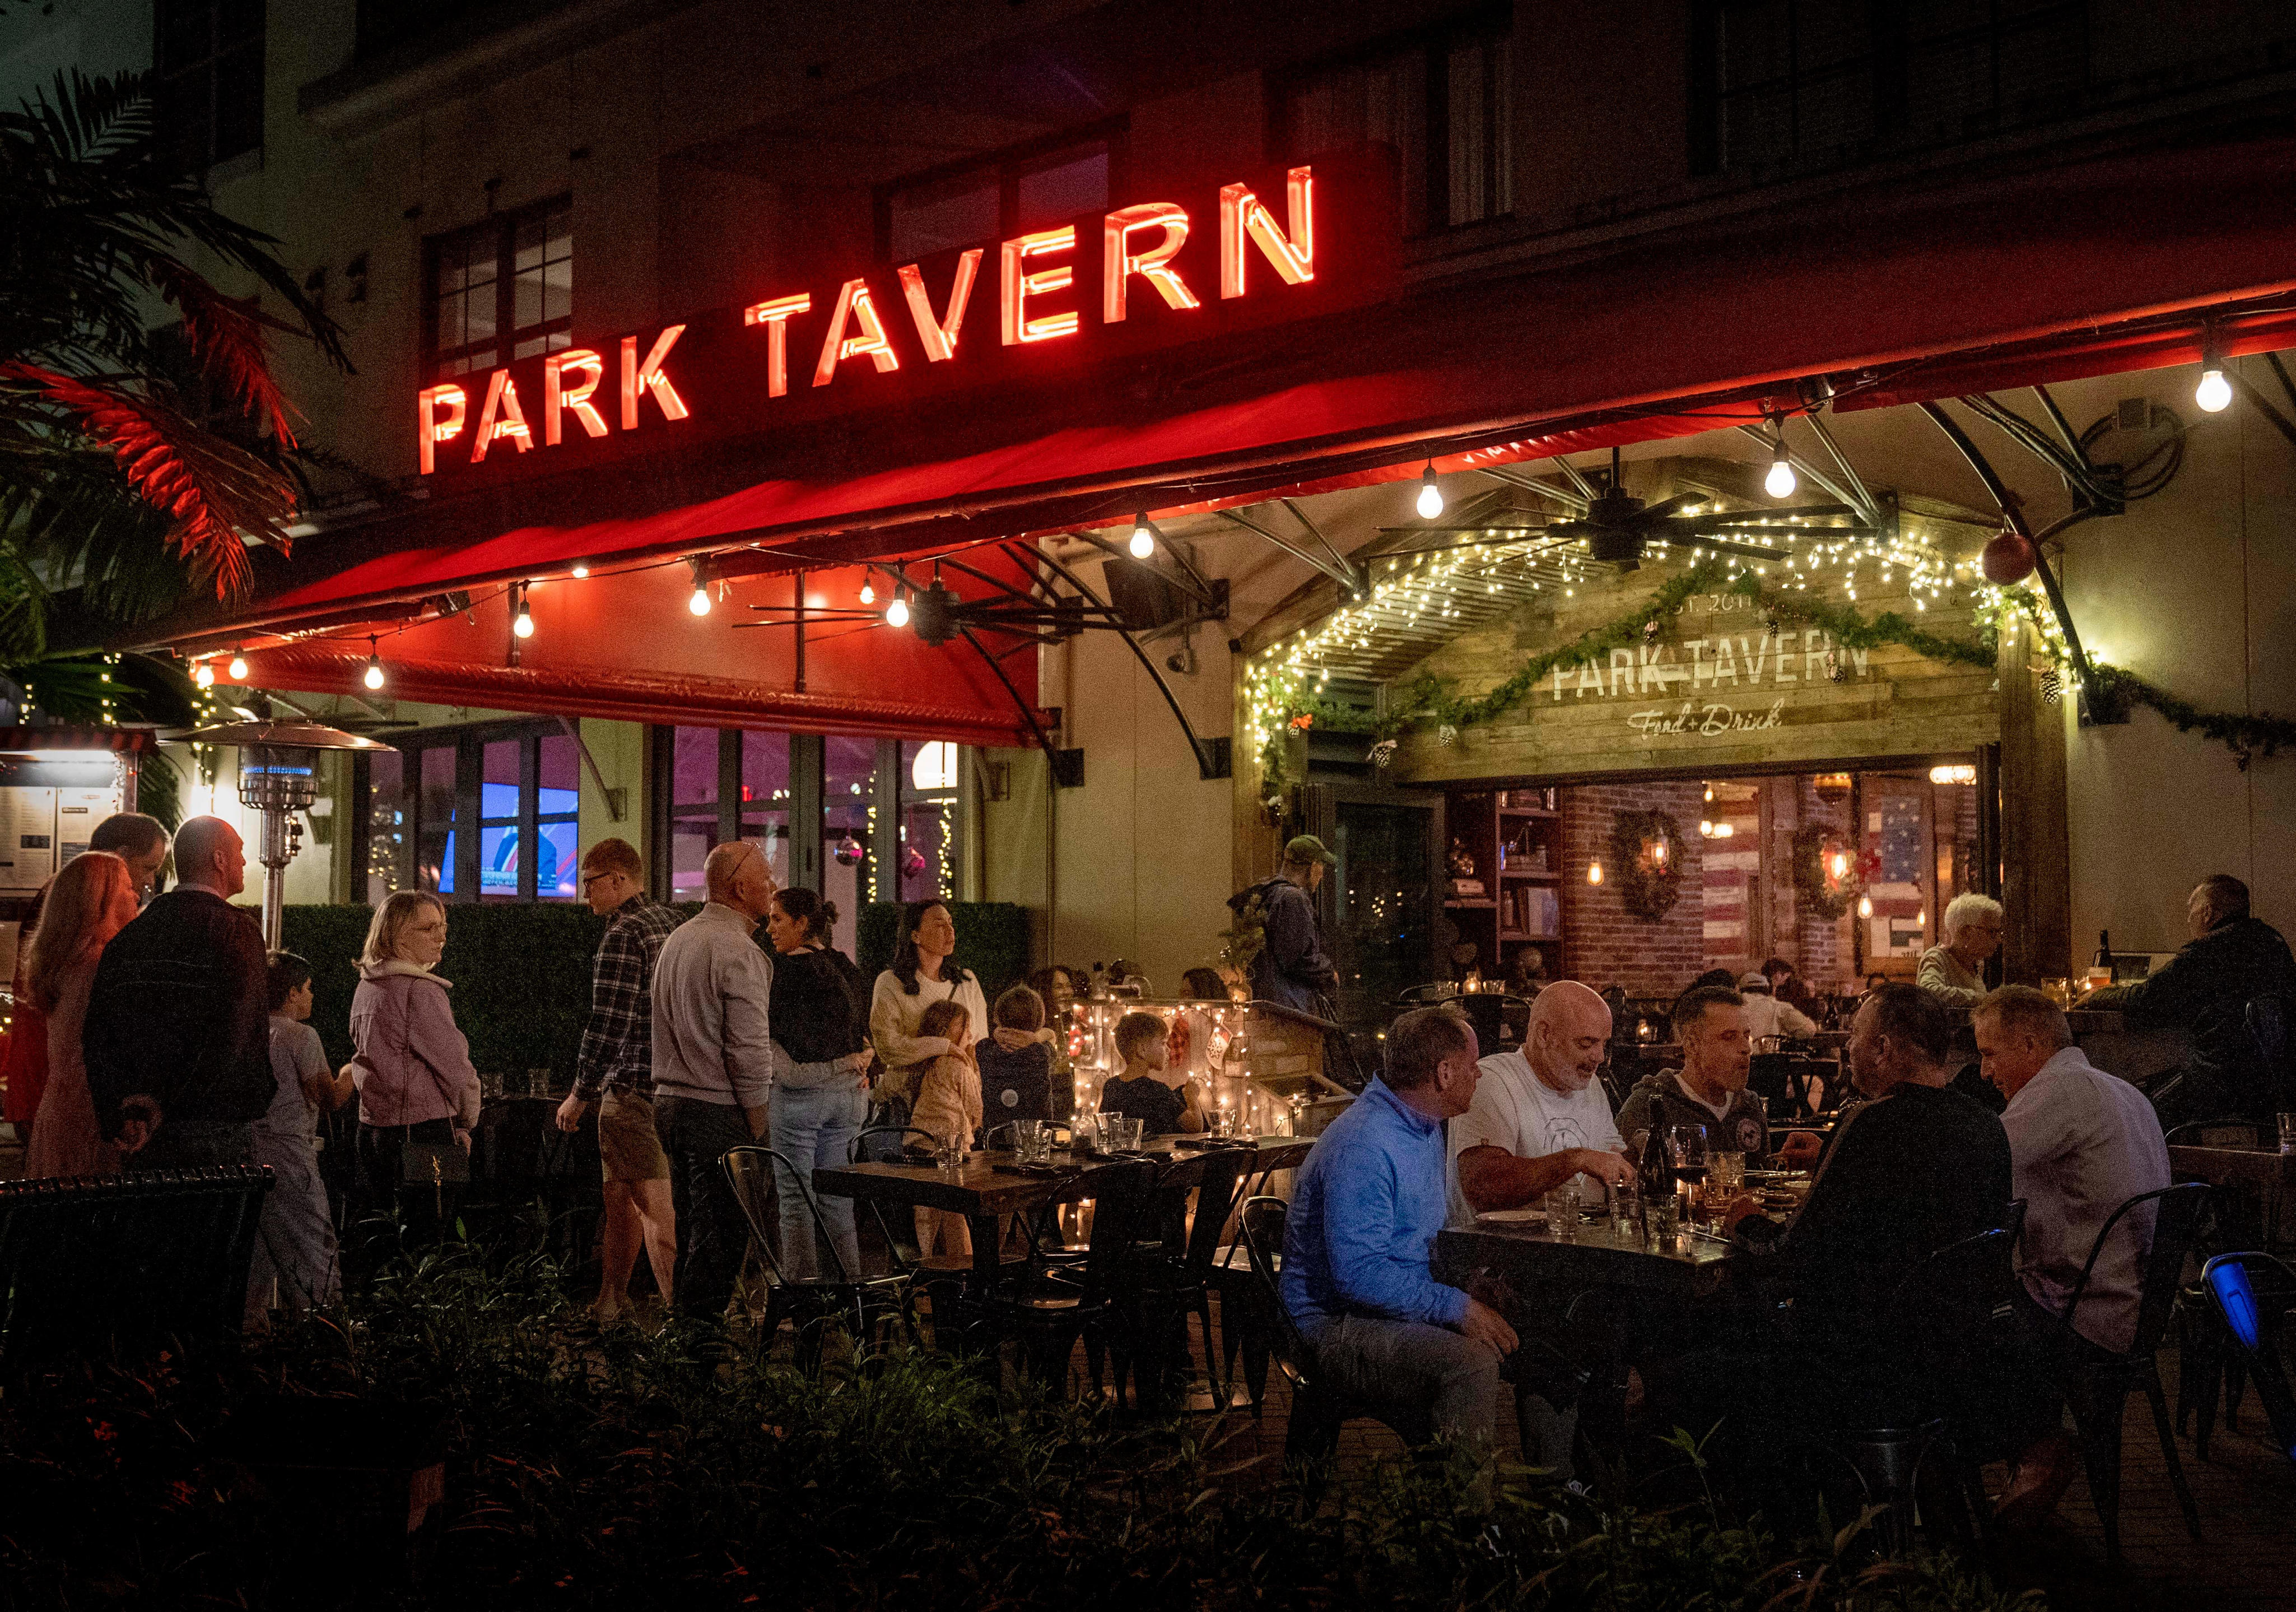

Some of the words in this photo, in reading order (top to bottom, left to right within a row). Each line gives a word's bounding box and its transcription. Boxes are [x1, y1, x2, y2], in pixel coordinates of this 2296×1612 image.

[419, 324, 689, 475] PARK
[745, 165, 1314, 397] TAVERN
[1708, 593, 1751, 612] 2011
[1553, 643, 1666, 700] PARK
[1683, 629, 1868, 689] TAVERN
[1699, 698, 1784, 736] Drink
